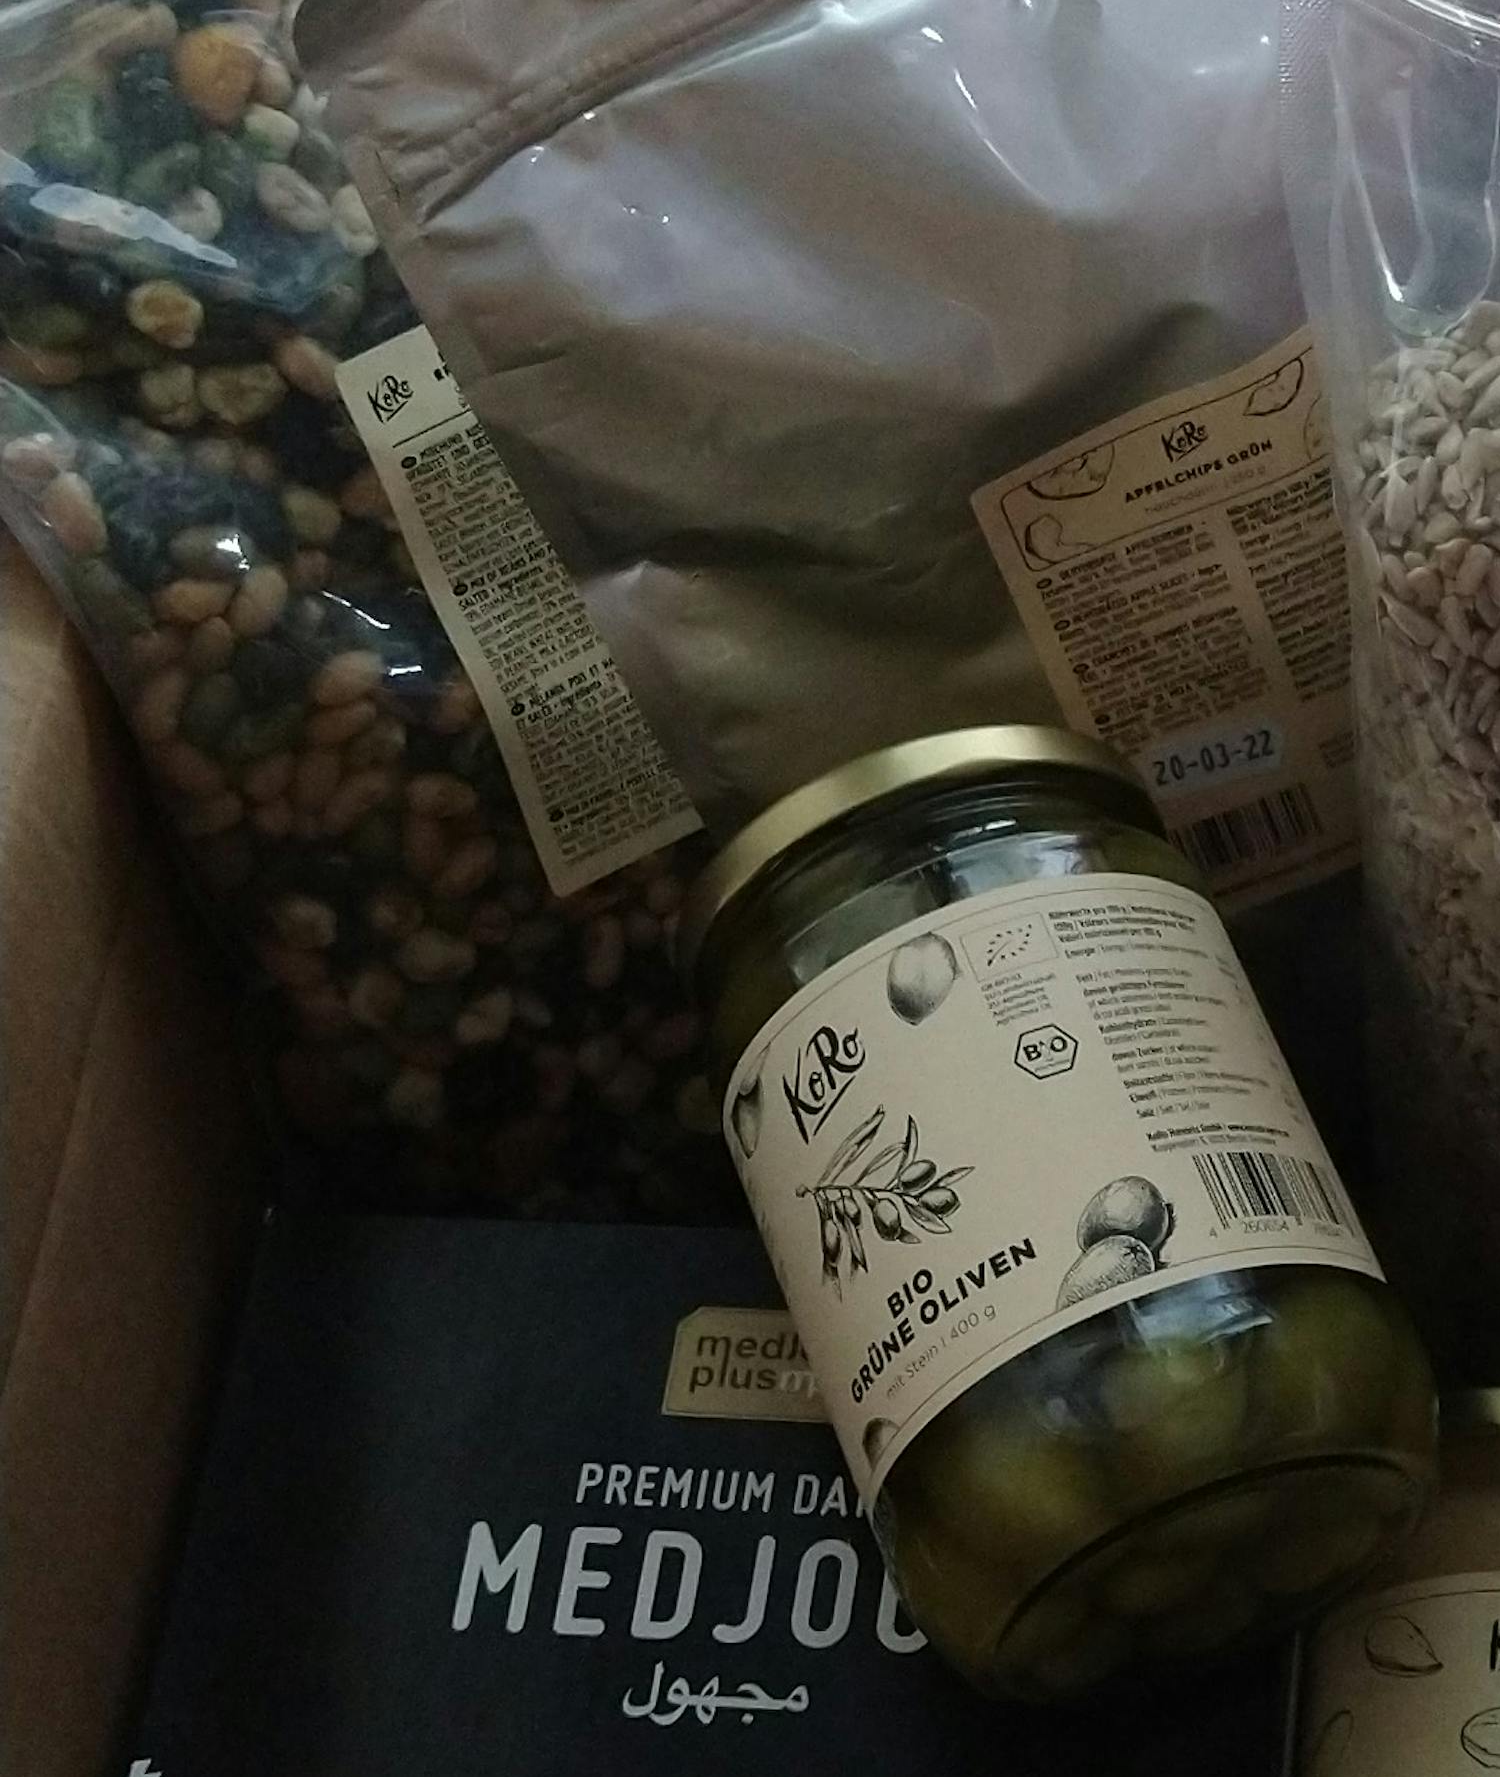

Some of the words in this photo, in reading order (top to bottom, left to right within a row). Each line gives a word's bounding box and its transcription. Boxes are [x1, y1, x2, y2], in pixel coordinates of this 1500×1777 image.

[368, 375, 413, 423] KoRo
[1161, 422, 1209, 462] KoRo
[1125, 460, 1224, 502] APFELCHIPS
[1226, 439, 1273, 466] GRÜN
[1153, 730, 1274, 785] 20-03-22
[782, 1025, 866, 1145] KoRo
[851, 1318, 915, 1403] GRÜNE
[920, 1238, 1036, 1325] OLIVEN
[887, 1269, 933, 1319] BIO
[951, 1312, 979, 1339] 400
[575, 1462, 775, 1513] PREMIUM
[621, 1661, 810, 1726] مجهول
